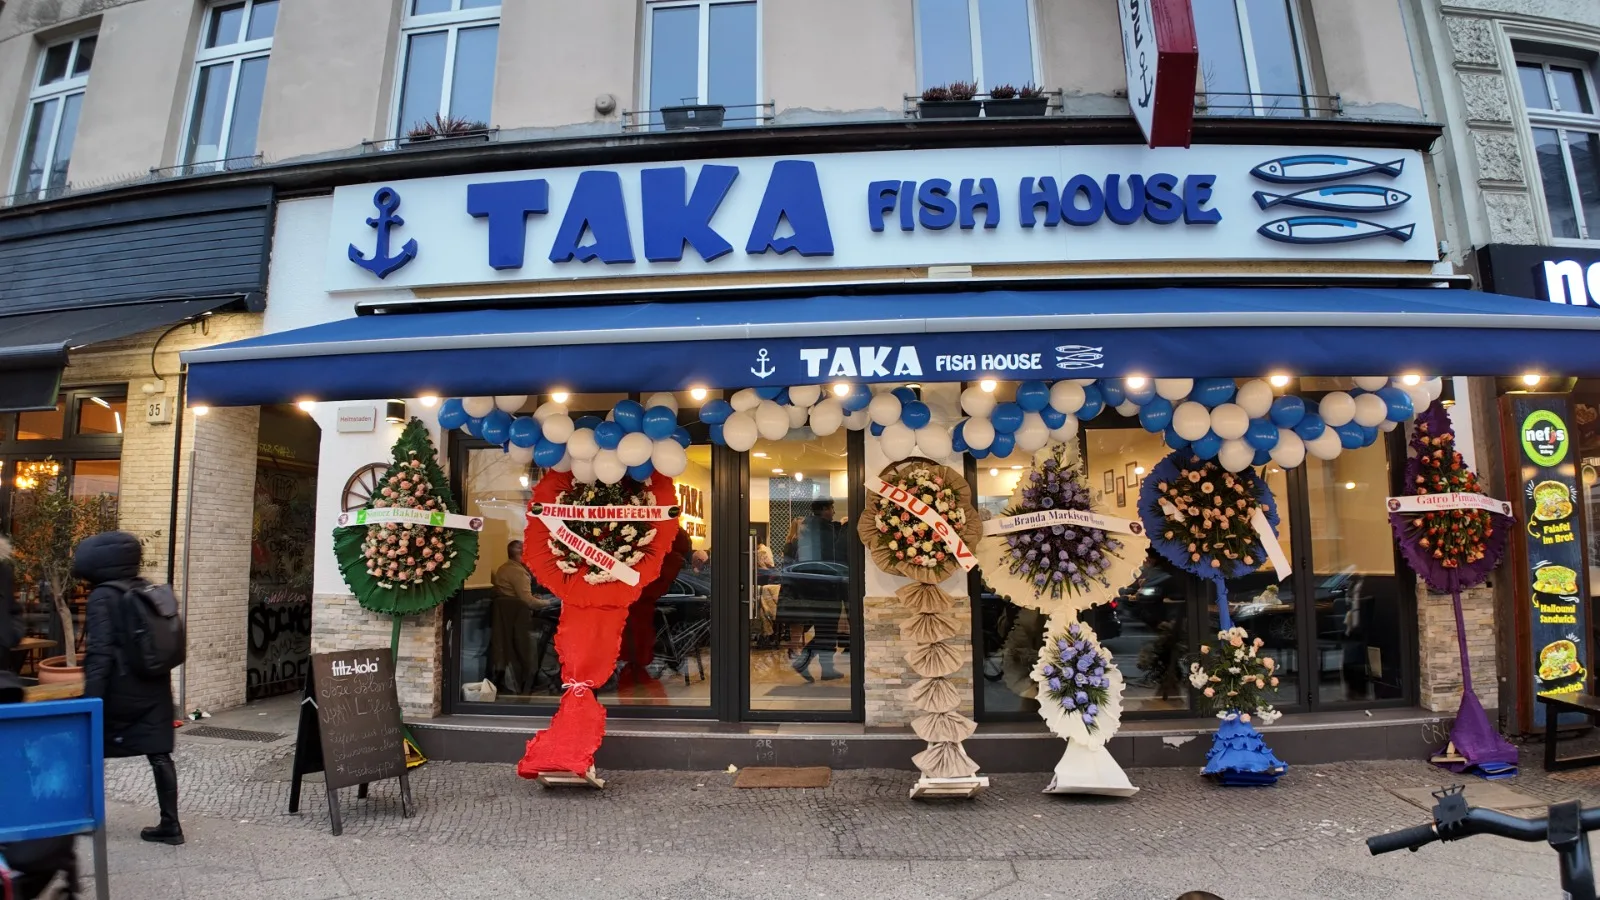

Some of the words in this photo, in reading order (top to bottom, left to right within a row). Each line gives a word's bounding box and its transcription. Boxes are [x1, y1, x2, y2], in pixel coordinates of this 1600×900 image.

[467, 160, 834, 270] TAKA
[867, 177, 1000, 232] FISH
[1019, 173, 1222, 229] HOUSE
[800, 345, 923, 378] TAKA
[936, 354, 976, 372] FISH
[985, 353, 1042, 371] HOUSE
[149, 403, 160, 417] 35
[879, 480, 930, 516] TDU
[393, 508, 430, 520] Baklava
[1014, 512, 1046, 526] Branda
[1049, 511, 1089, 522] Markisen
[1543, 522, 1571, 534] Falafel
[1555, 532, 1574, 543] Brot
[584, 545, 616, 571] OLSUN
[1540, 604, 1576, 614] Halloumi
[1540, 614, 1576, 624] Sandwich
[331, 657, 378, 677] fritz-kola
